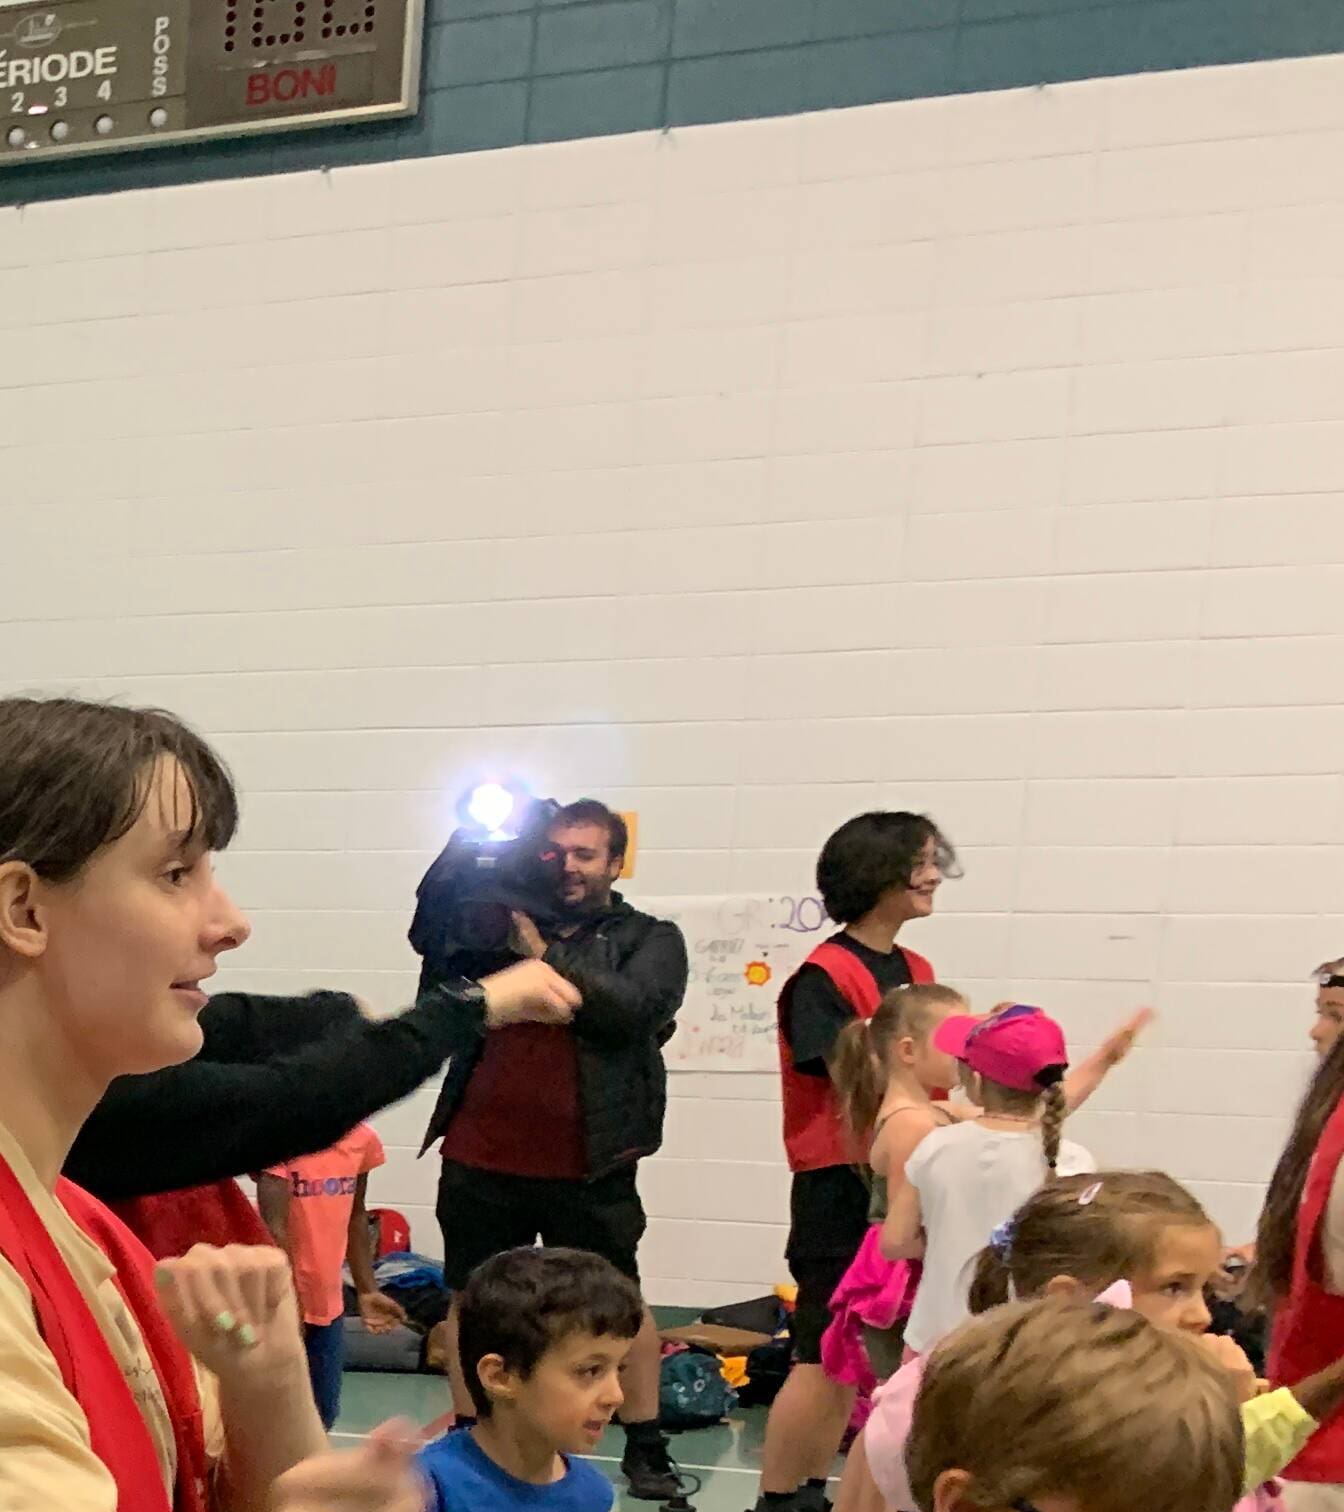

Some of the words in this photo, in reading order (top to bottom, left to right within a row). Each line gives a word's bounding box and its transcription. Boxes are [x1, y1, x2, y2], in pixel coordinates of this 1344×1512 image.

[151, 16, 170, 98] POSS
[11, 91, 24, 113] 2
[54, 86, 68, 108] 3
[97, 79, 112, 101] 4
[246, 64, 337, 106] BONI
